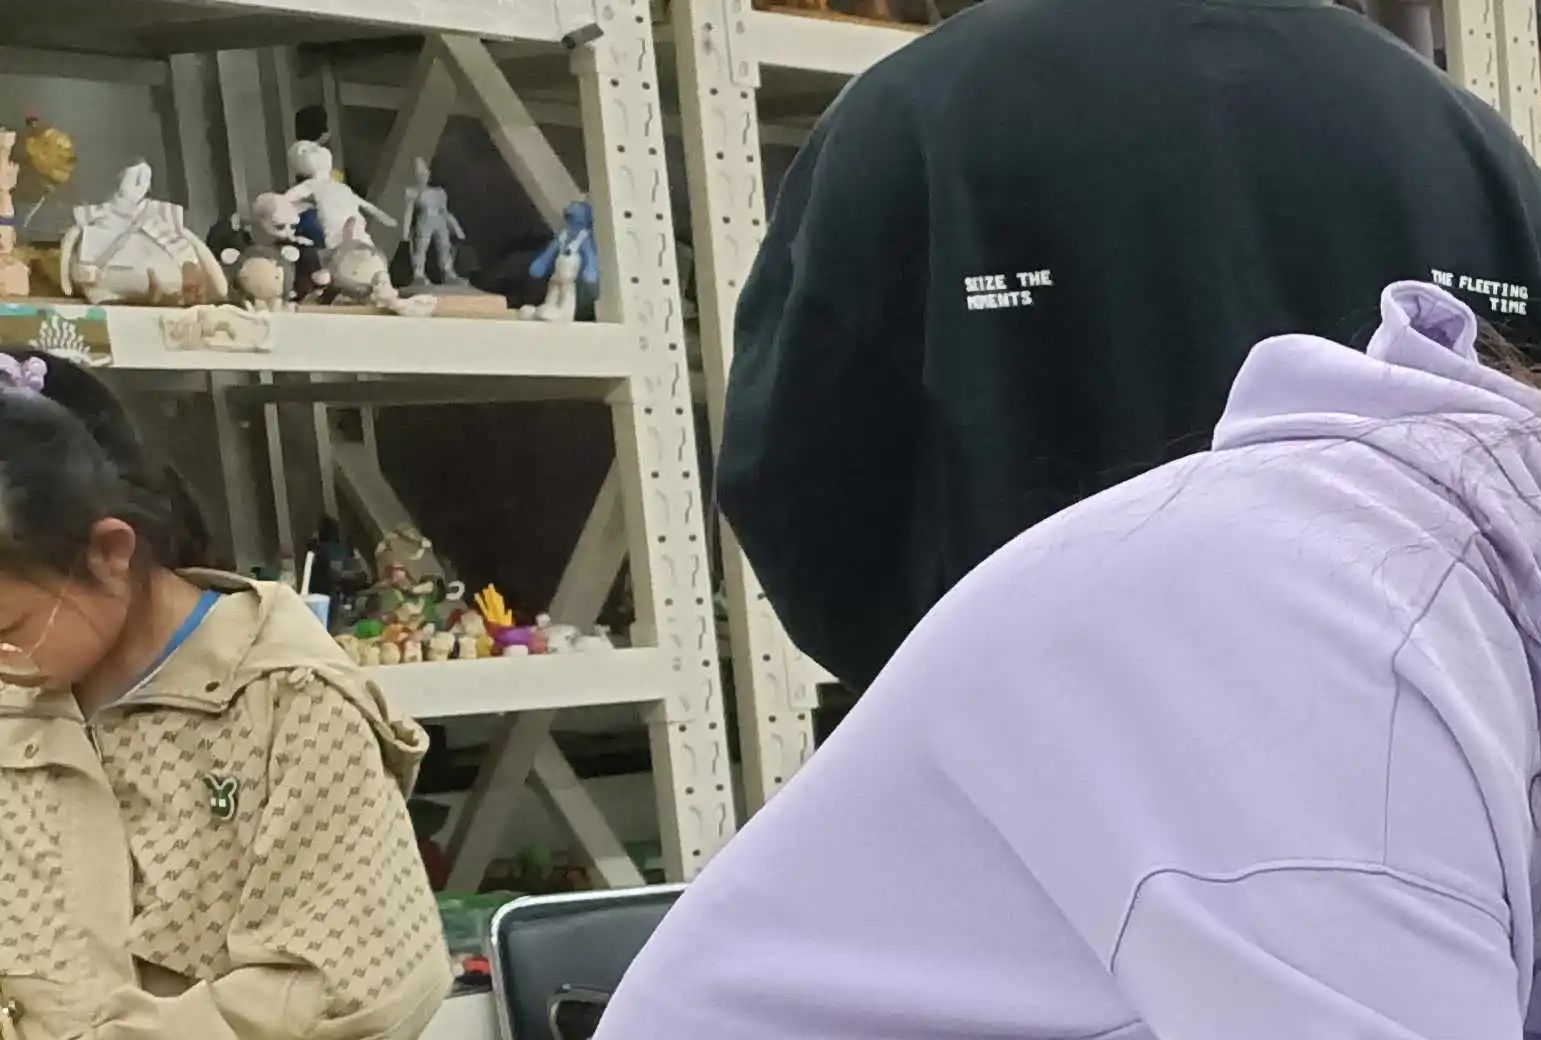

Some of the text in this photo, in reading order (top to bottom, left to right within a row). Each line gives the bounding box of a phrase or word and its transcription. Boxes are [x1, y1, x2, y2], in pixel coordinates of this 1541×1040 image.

[964, 269, 1053, 292] SEIZE THE
[1431, 268, 1529, 300] THE FLEETING
[1489, 296, 1527, 315] TIME
